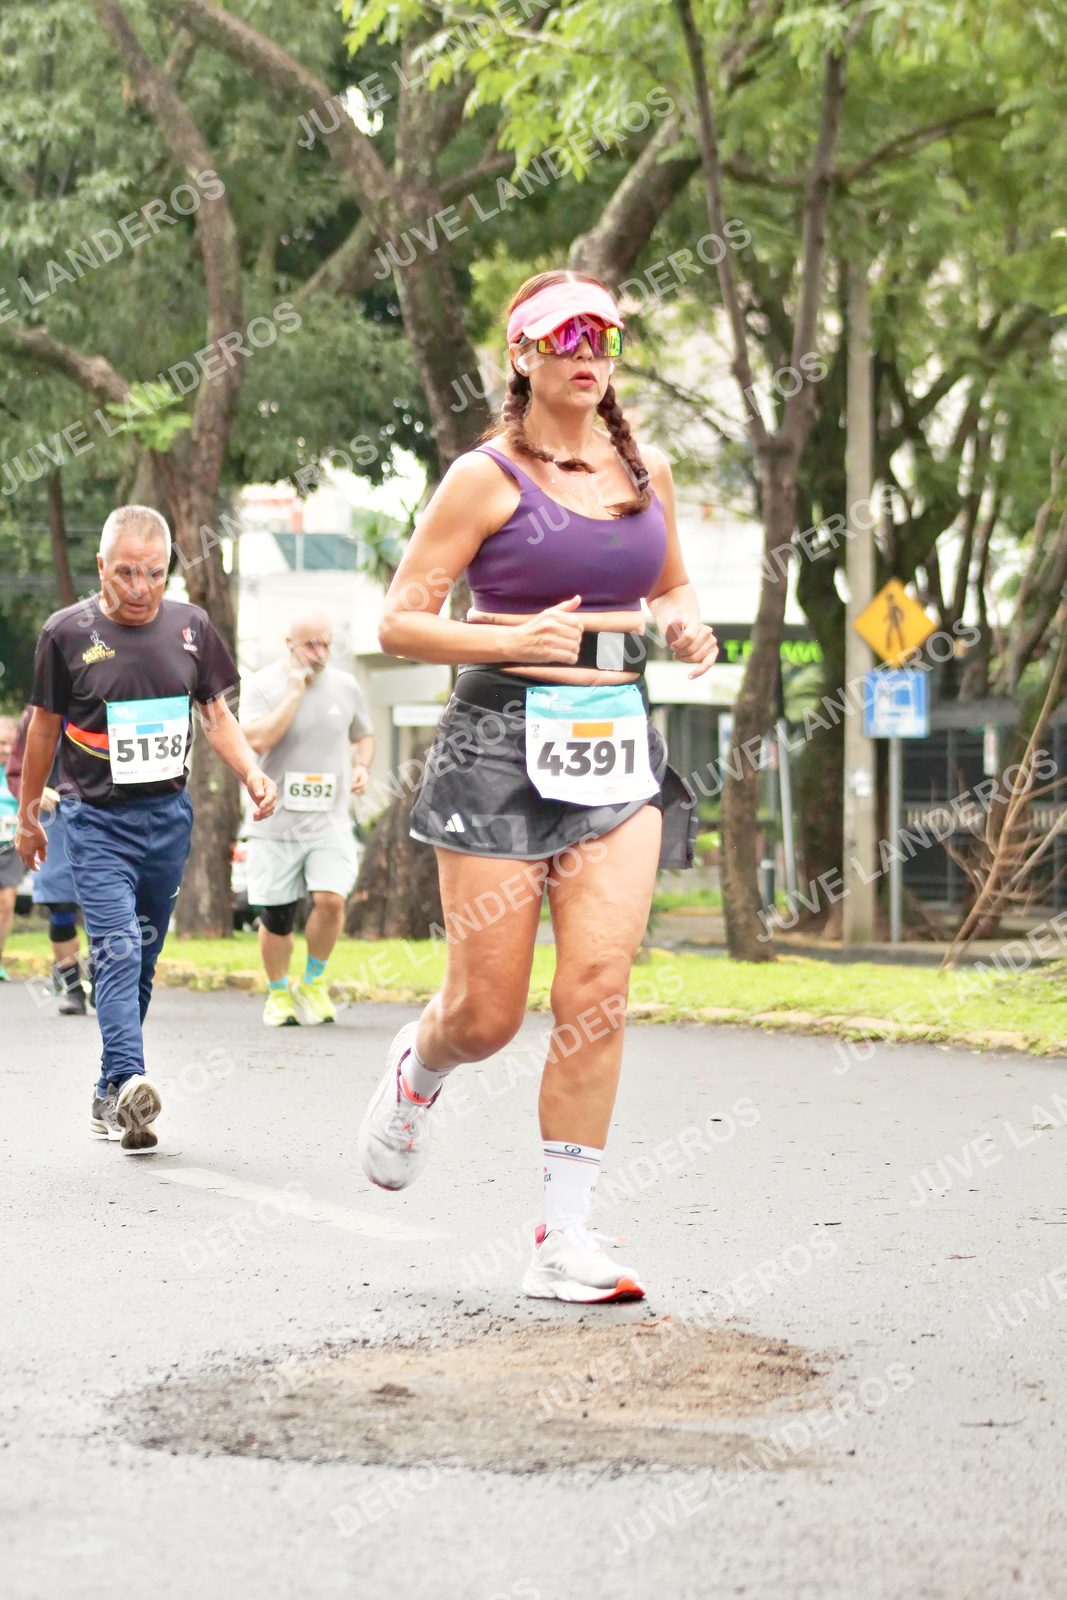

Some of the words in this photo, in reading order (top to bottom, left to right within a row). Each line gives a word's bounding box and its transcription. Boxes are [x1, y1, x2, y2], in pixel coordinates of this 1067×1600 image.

[117, 734, 182, 763] 5138
[537, 739, 635, 777] 4391
[289, 783, 333, 798] 6592
